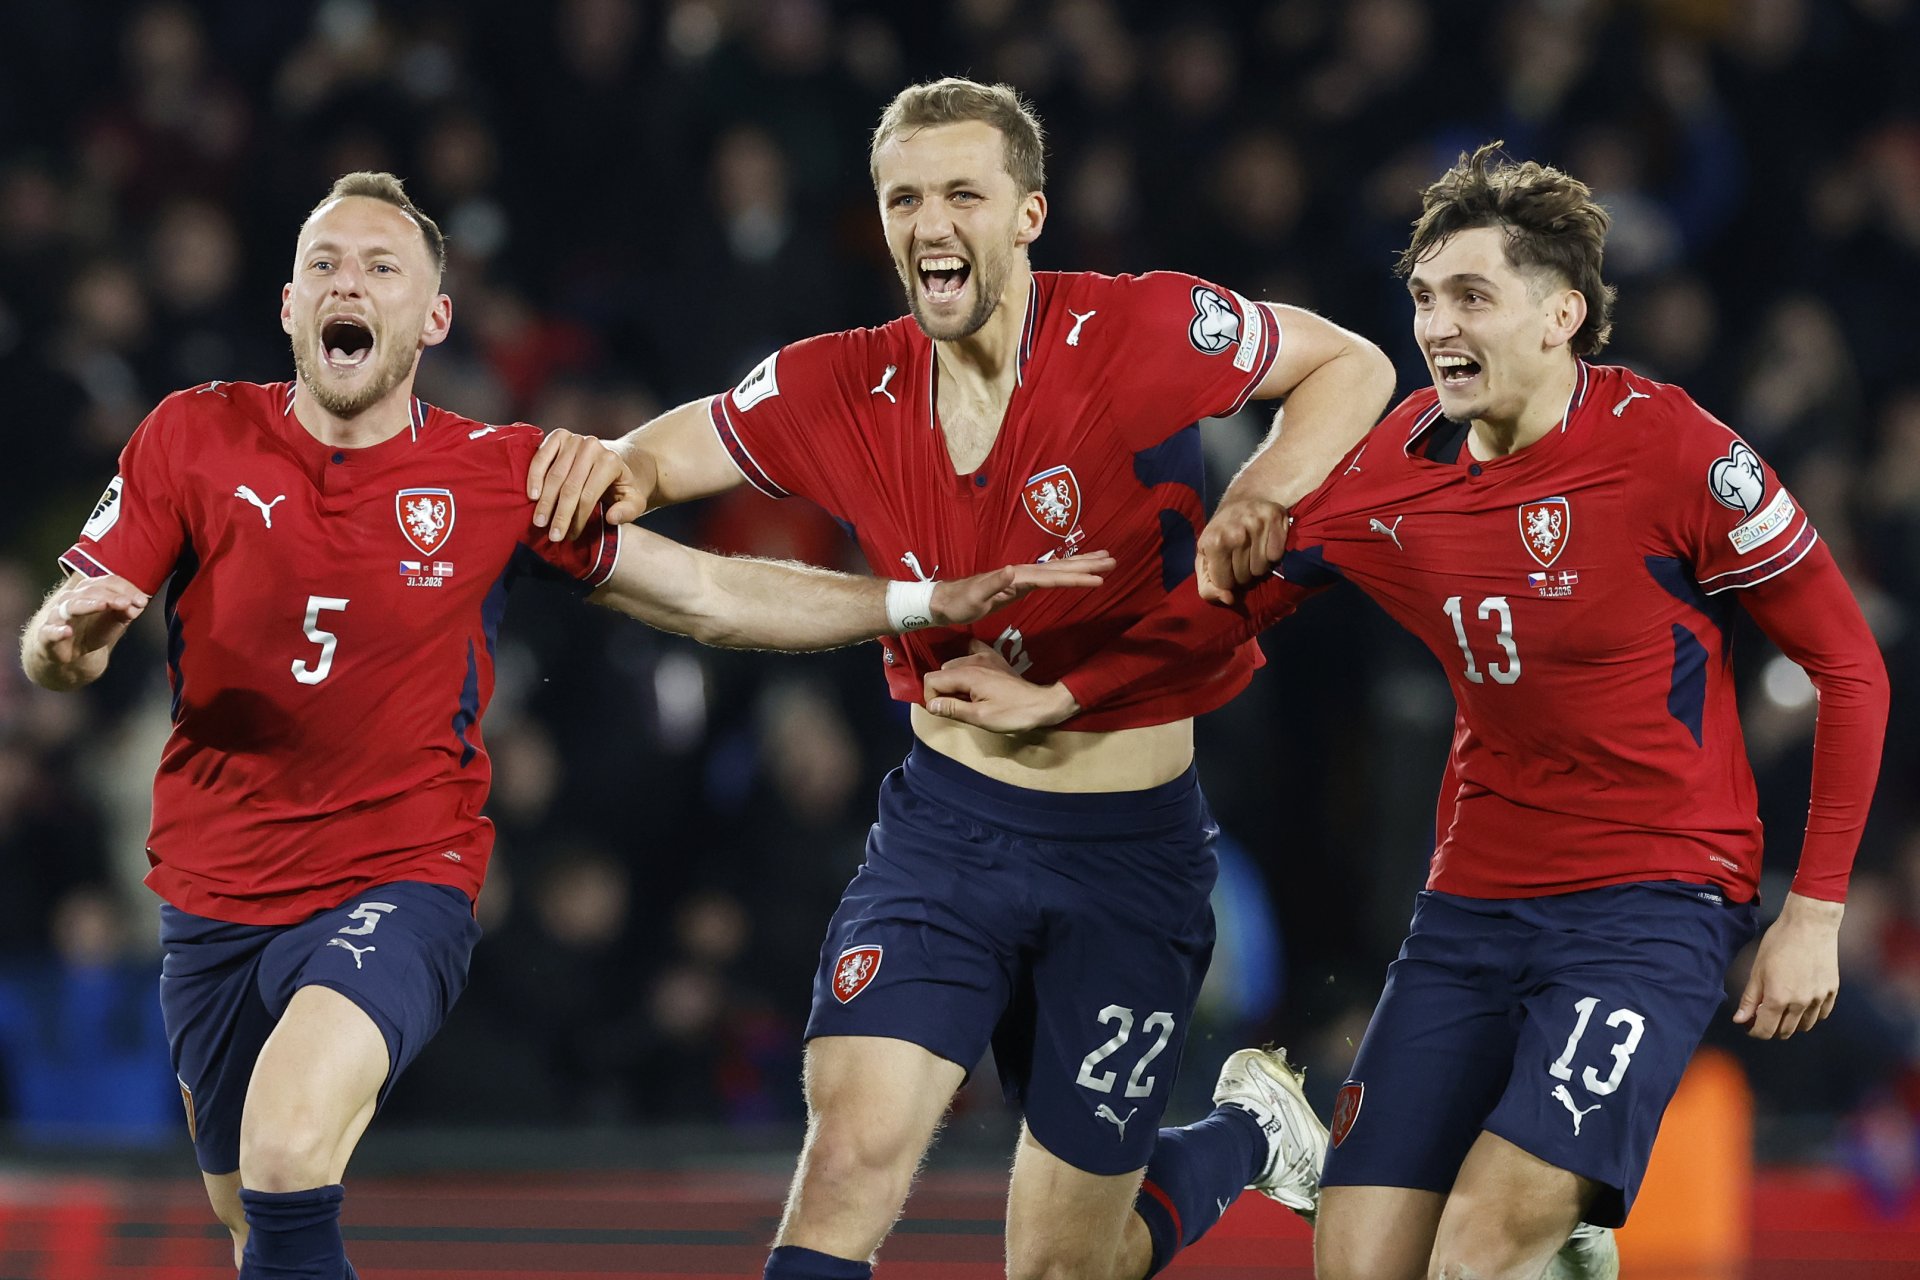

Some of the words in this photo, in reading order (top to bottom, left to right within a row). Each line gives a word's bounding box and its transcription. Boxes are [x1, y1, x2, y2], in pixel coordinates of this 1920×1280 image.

[1731, 526, 1750, 539] UEFA
[406, 576, 443, 587] 31.3.2026
[290, 595, 350, 685] 5
[1442, 596, 1521, 685] 13
[337, 902, 398, 936] 5
[1075, 1004, 1175, 1098] 22
[1548, 996, 1646, 1096] 13
